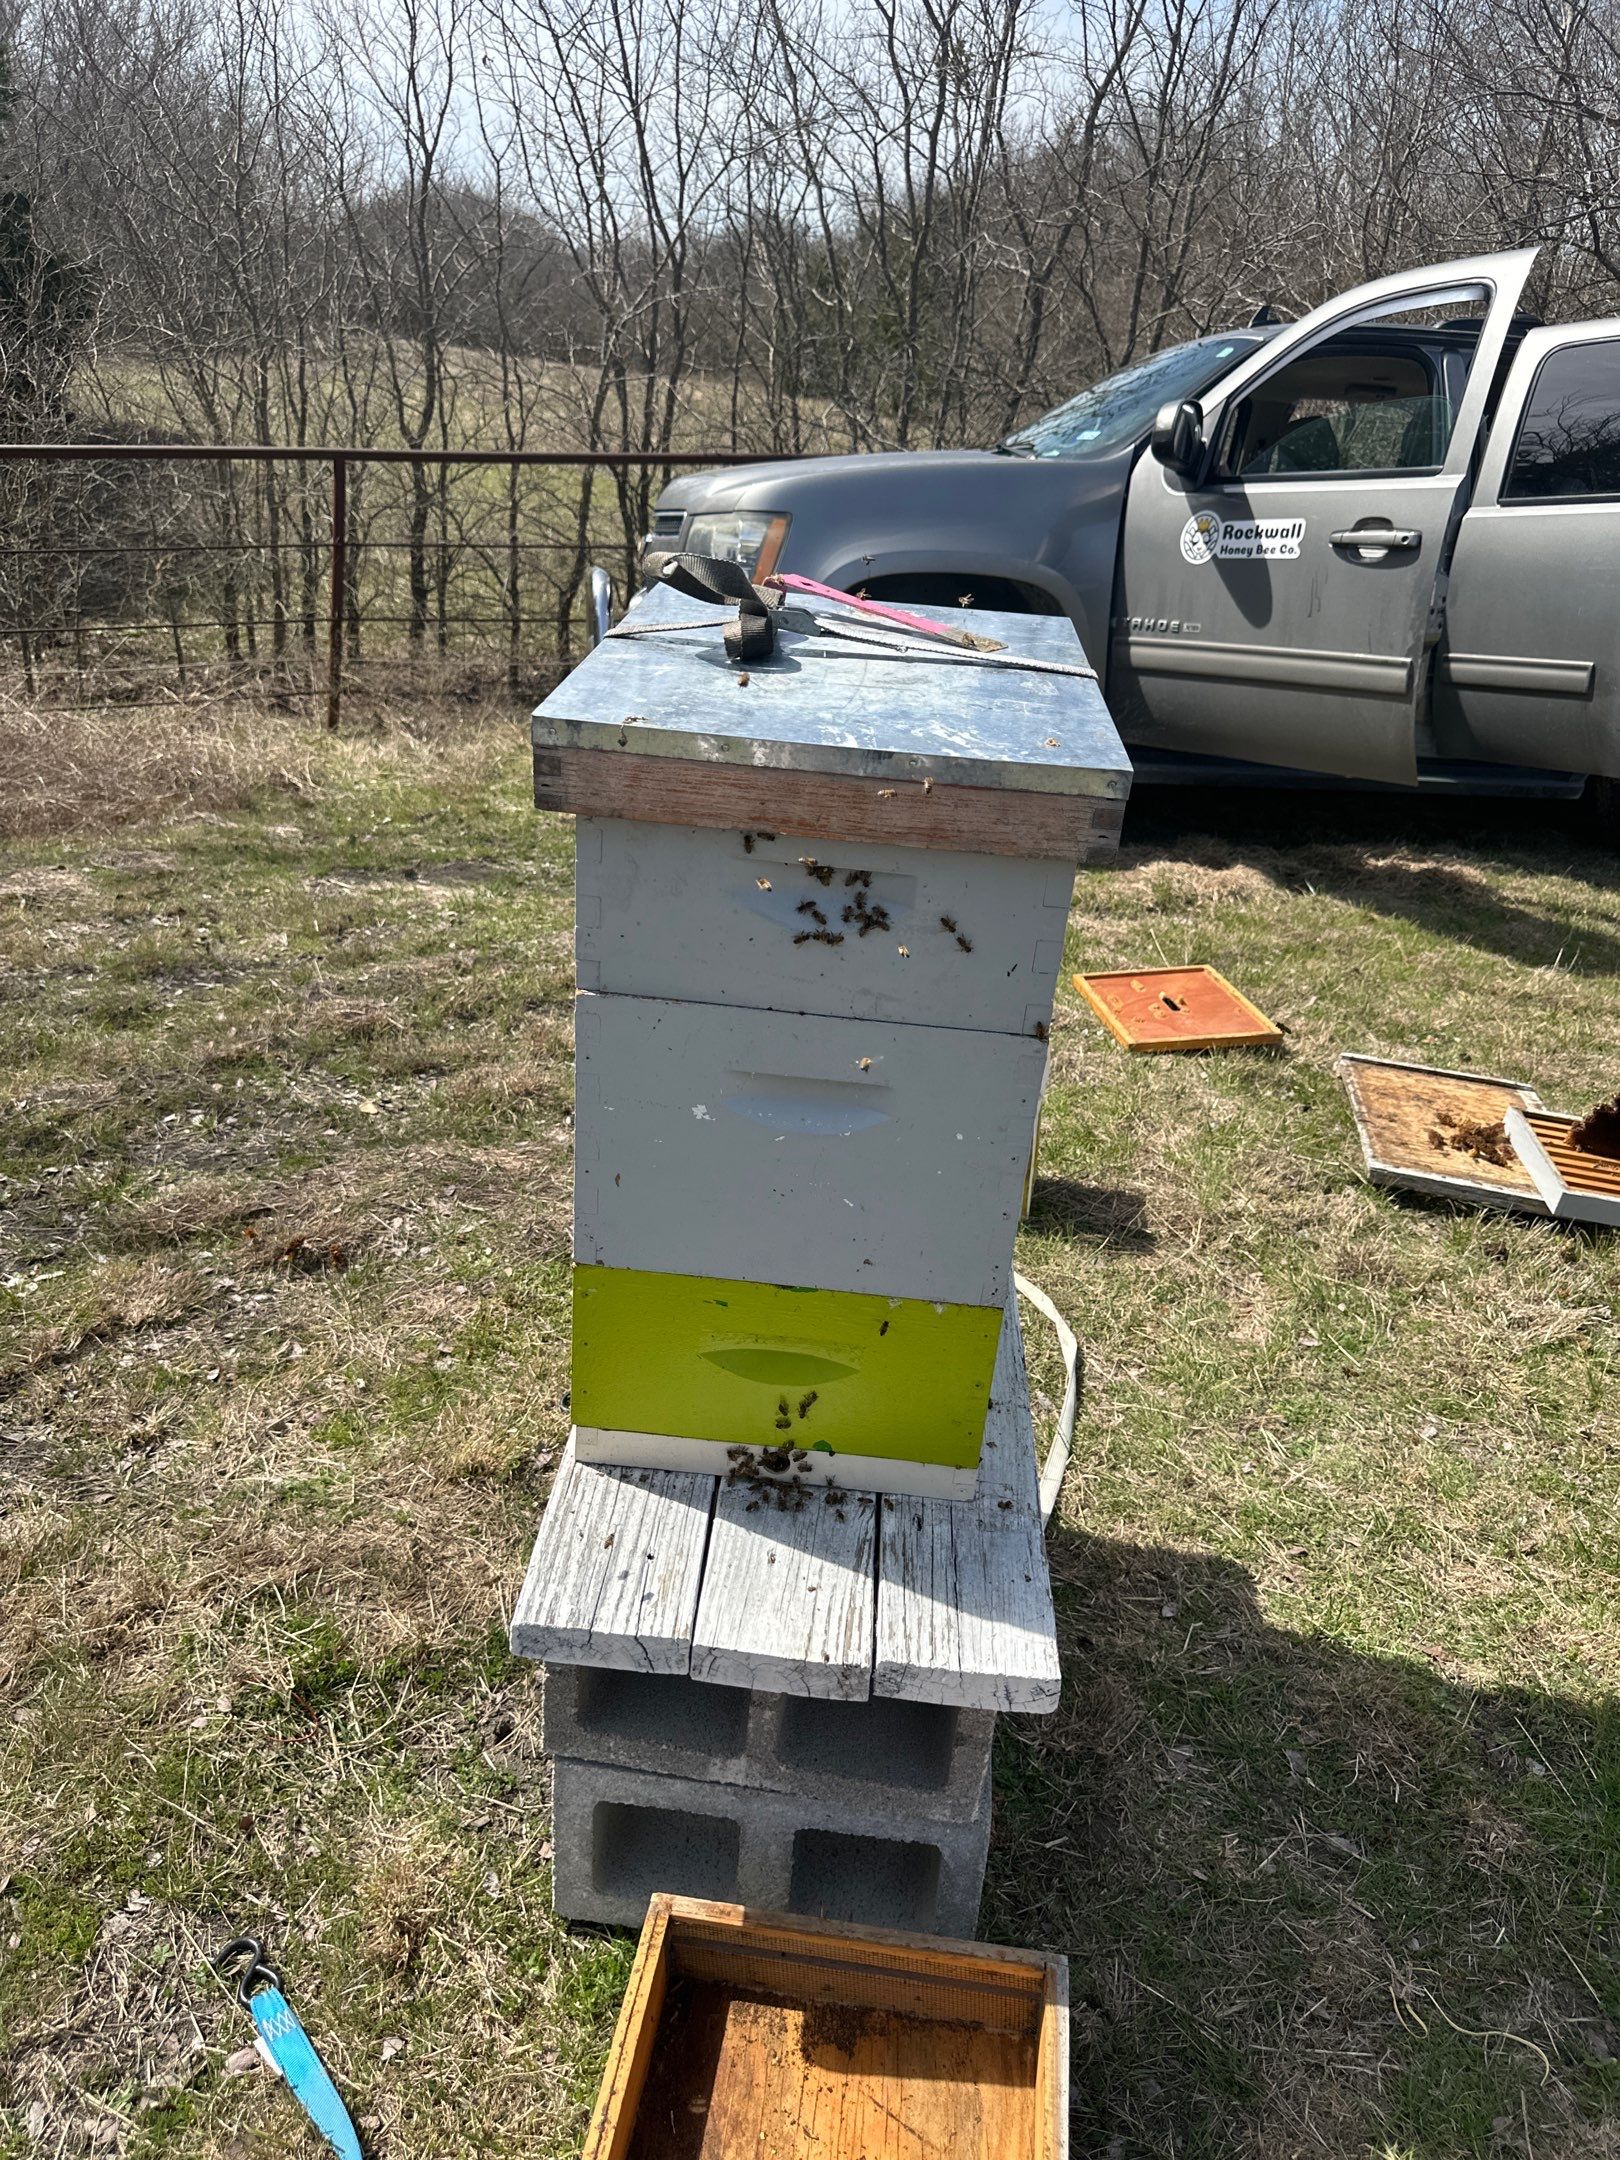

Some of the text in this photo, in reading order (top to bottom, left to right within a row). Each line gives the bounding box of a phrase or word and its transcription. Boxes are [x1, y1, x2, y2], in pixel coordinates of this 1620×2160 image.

[1222, 523, 1302, 540] Rockwall
[1220, 544, 1298, 558] Honey Bee Co.
[1126, 616, 1180, 633] AHOE
